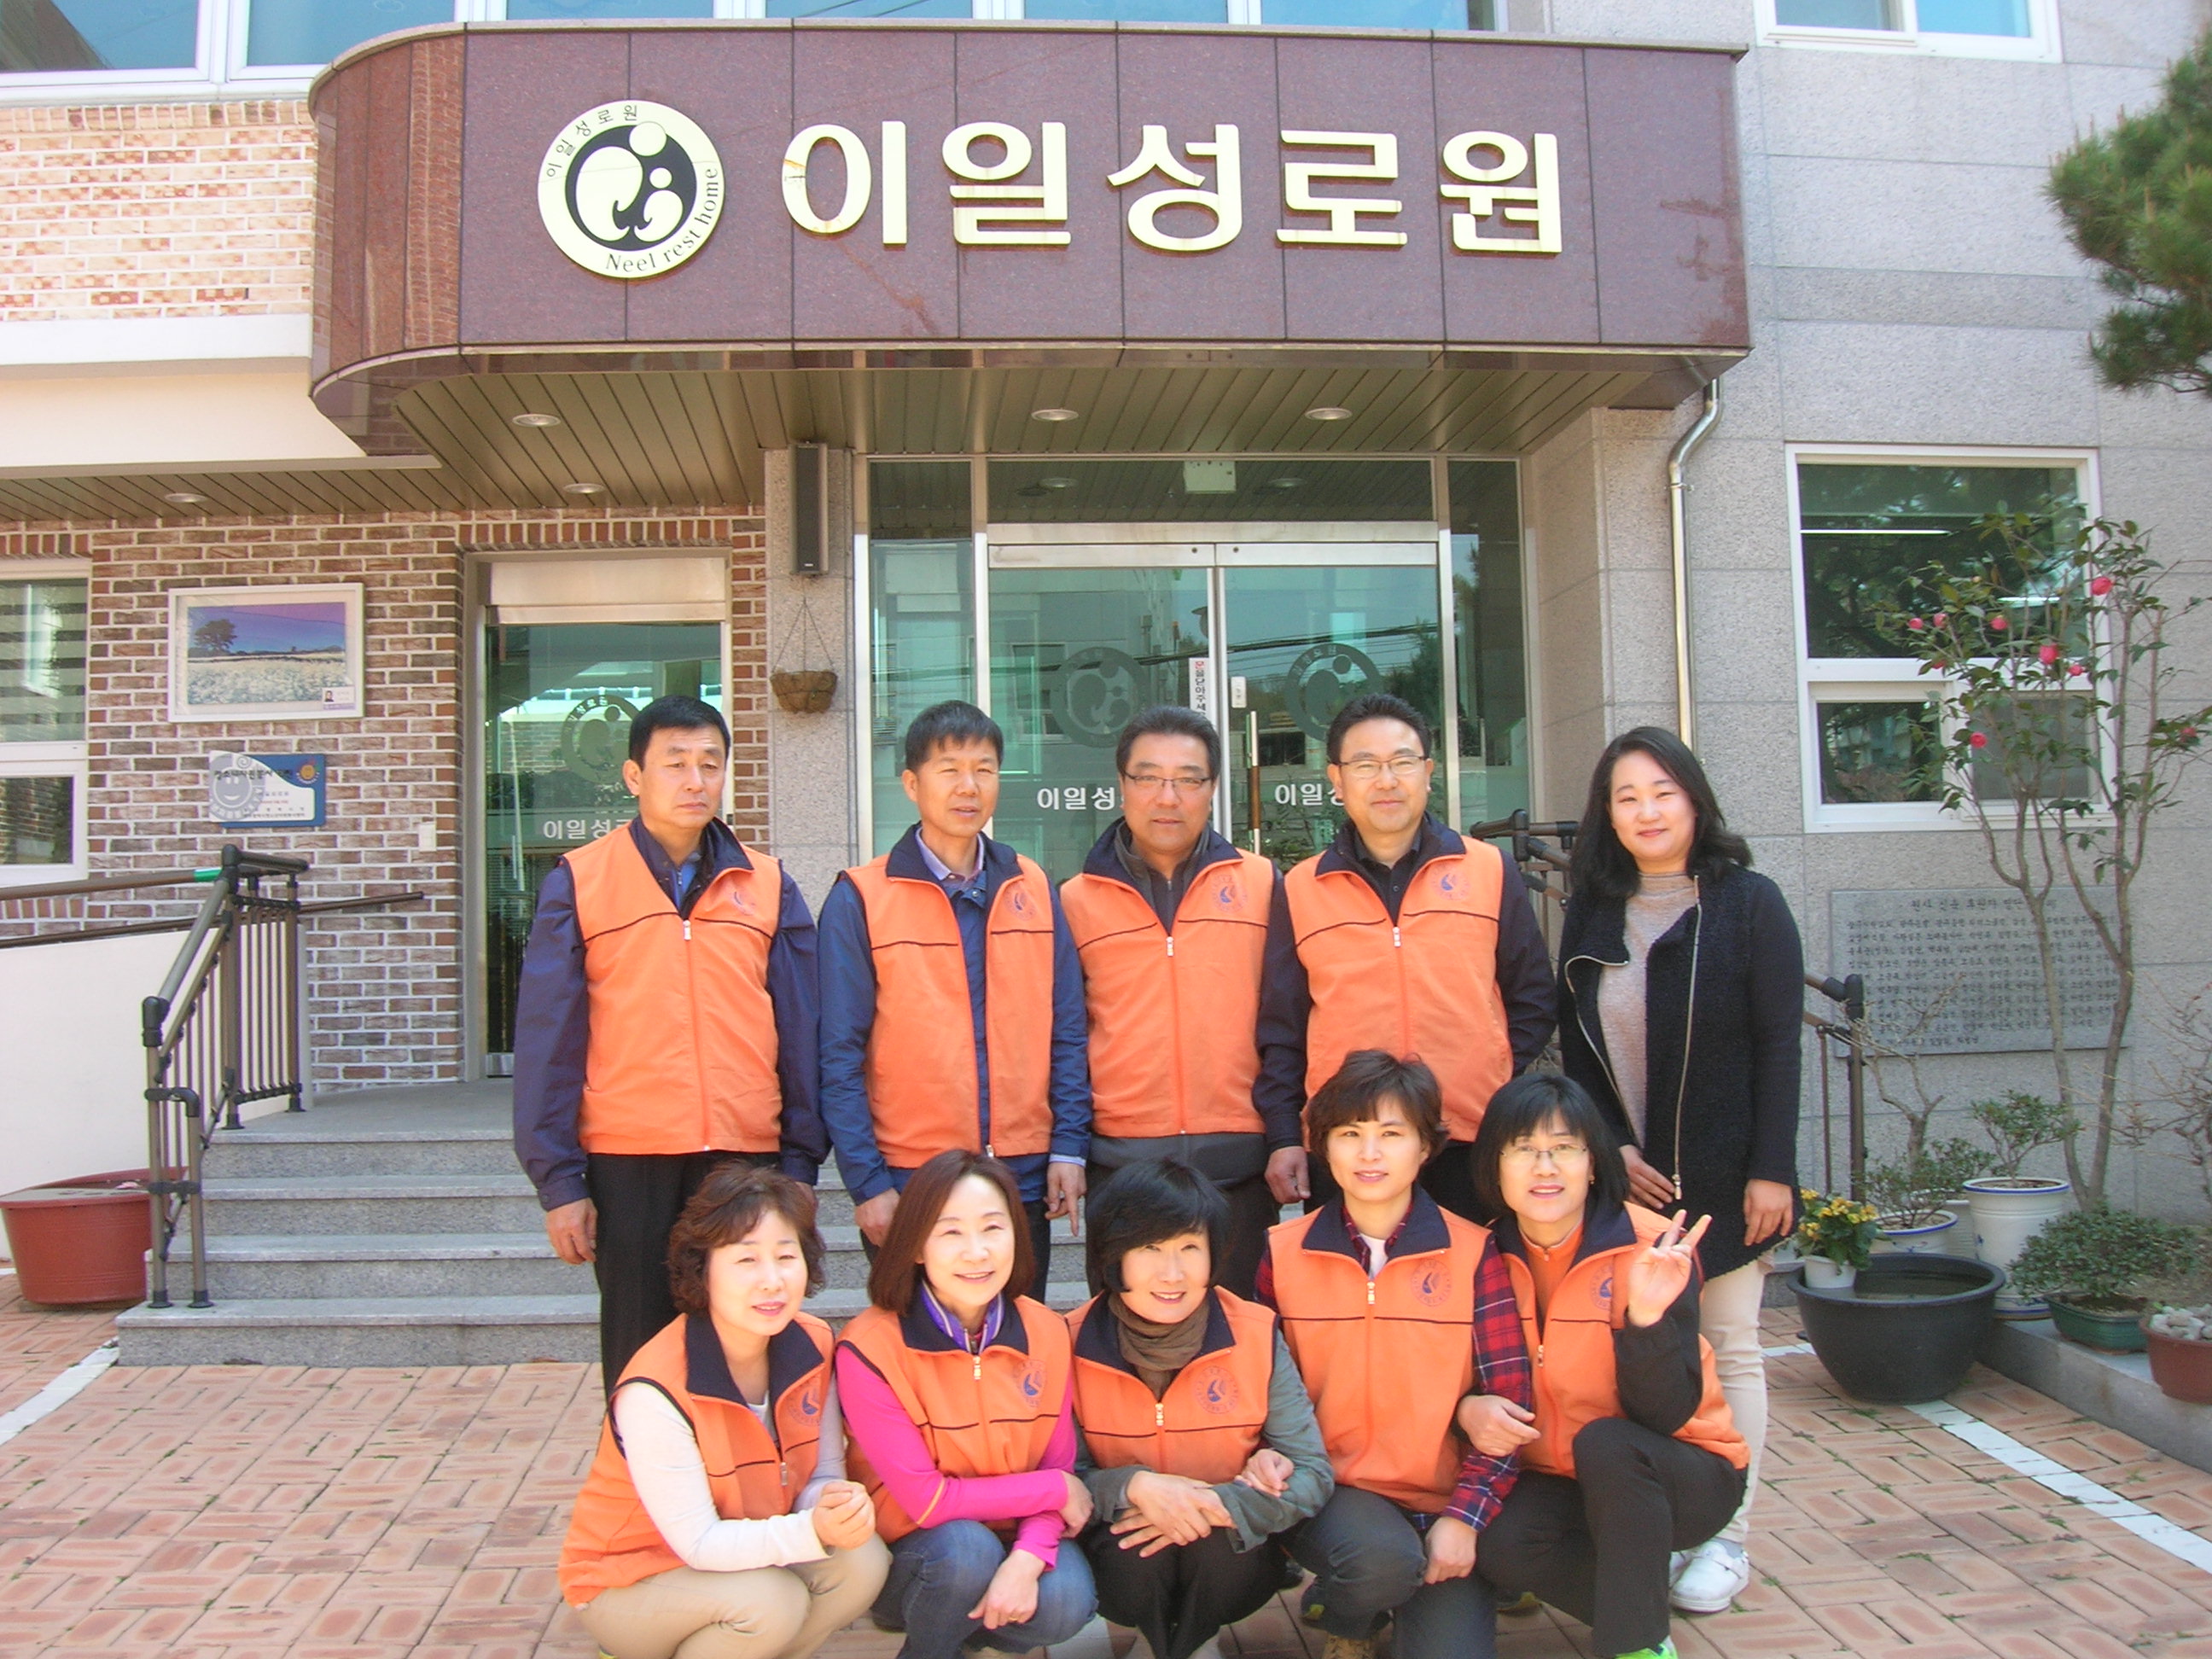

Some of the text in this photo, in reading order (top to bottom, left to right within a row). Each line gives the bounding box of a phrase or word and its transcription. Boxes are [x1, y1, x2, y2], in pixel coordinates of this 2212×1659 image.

[546, 104, 637, 178] 이일성로원
[781, 119, 1563, 253] 이일성로원
[606, 168, 719, 273] Neel rest home
